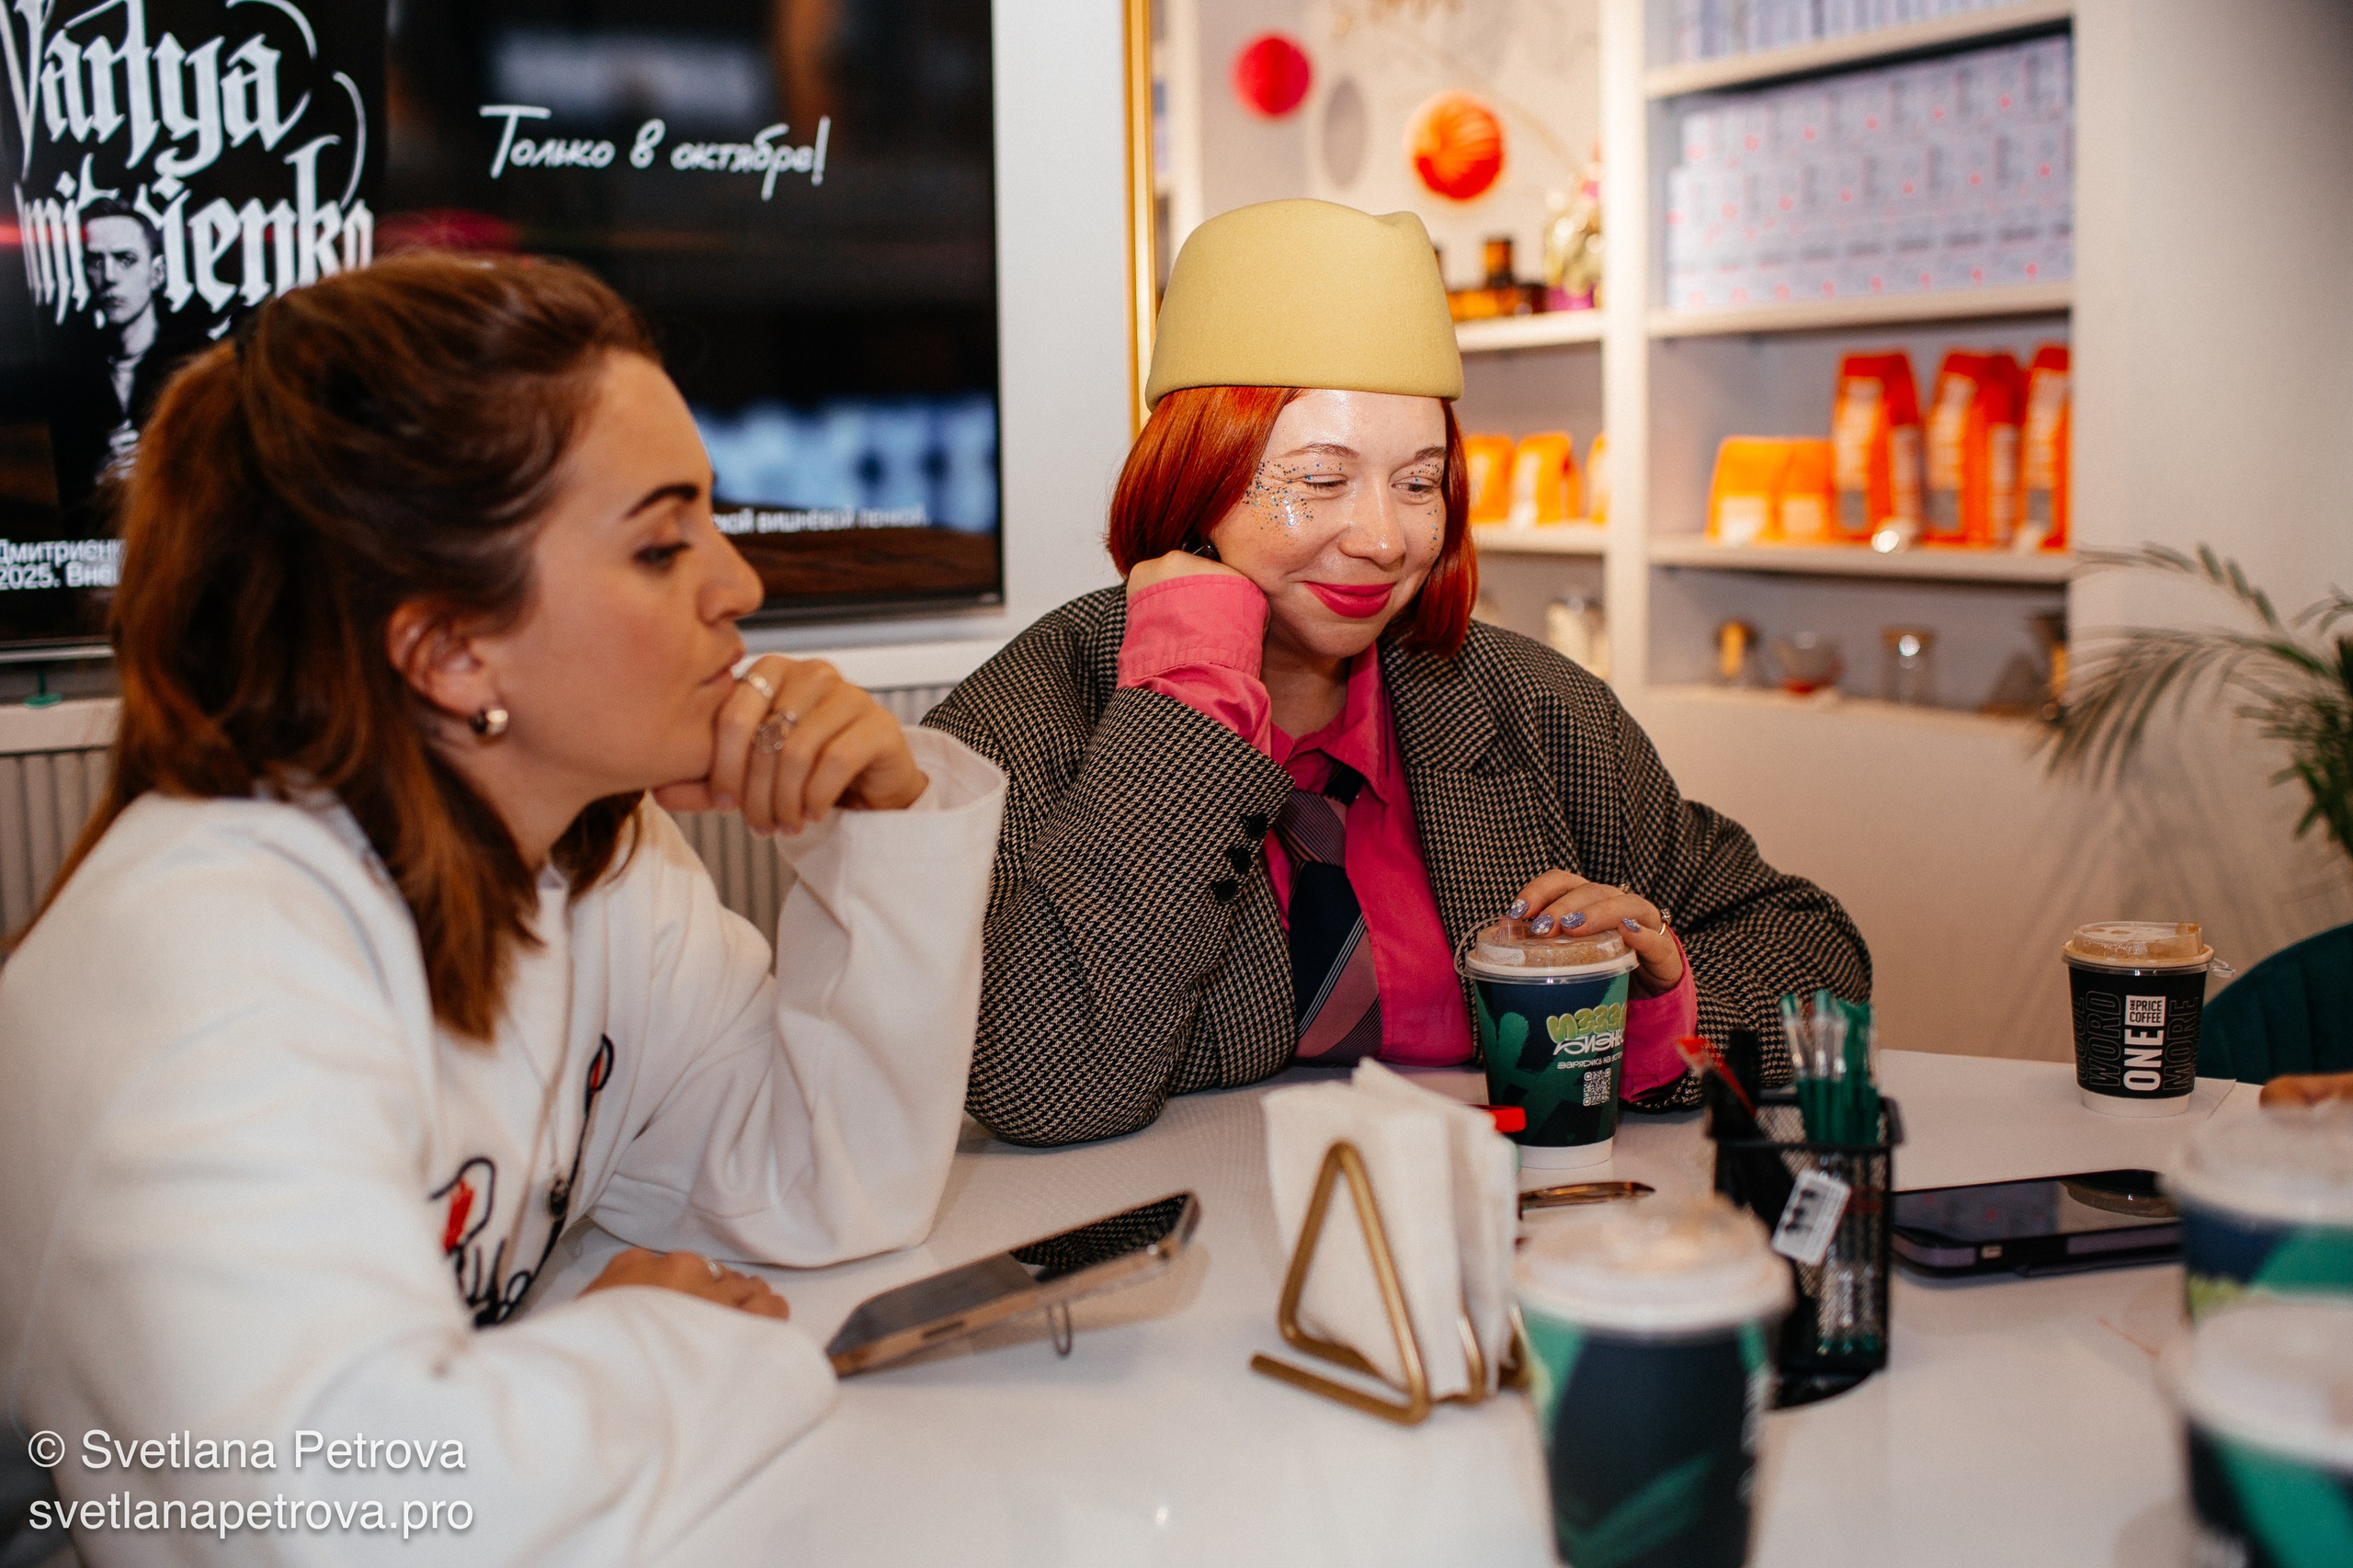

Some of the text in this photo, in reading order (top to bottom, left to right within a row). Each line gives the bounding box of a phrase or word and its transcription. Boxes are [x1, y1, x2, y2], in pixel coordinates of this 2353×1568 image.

[479, 105, 831, 200] Только в октябре!
[0, 561, 62, 591] 2025.
[2130, 1011, 2162, 1024] COFFEE
[2136, 1000, 2162, 1012] PRICE
[2086, 990, 2121, 1086] WORD
[2123, 1028, 2164, 1091] ONE
[2163, 995, 2200, 1091] MORE
